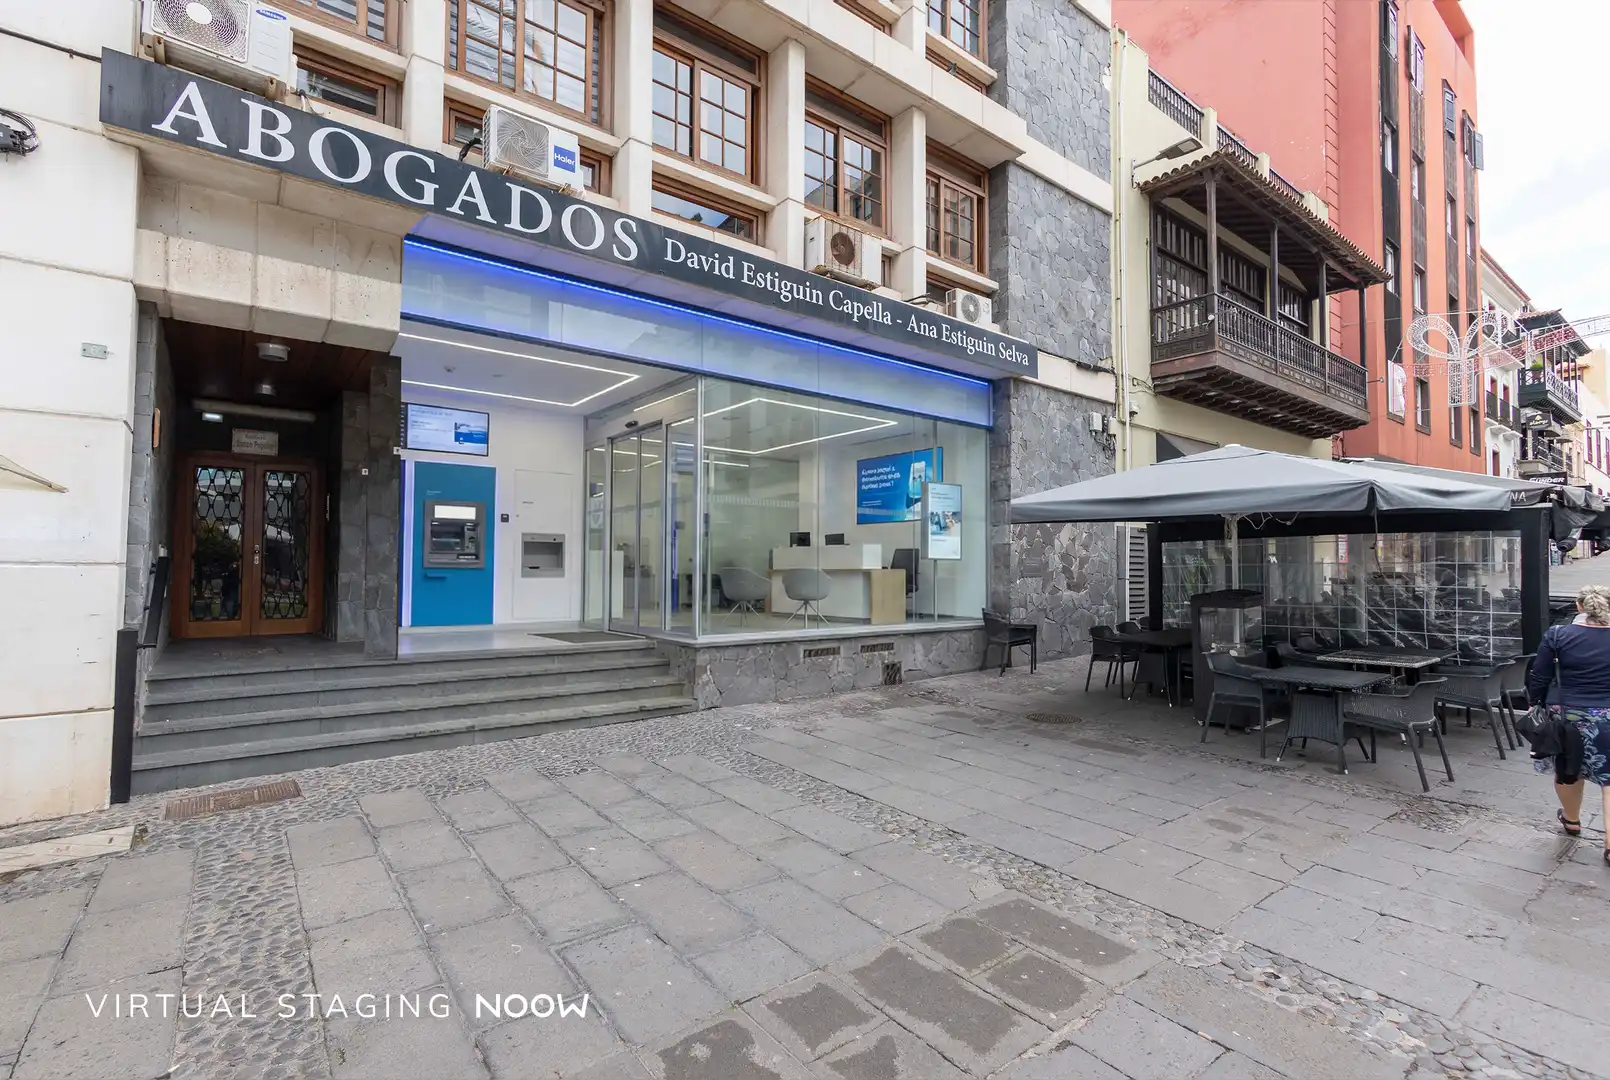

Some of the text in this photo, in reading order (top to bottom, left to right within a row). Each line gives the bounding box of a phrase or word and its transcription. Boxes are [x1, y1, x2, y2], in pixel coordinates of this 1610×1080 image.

[151, 81, 640, 262] ABOGADOS
[554, 152, 576, 166] Haier
[664, 238, 736, 281] David
[741, 260, 824, 306] Estiguin
[829, 289, 892, 327] Capella
[906, 314, 938, 340] Ana
[941, 325, 997, 358] Estiguin
[998, 341, 1030, 367] Selva
